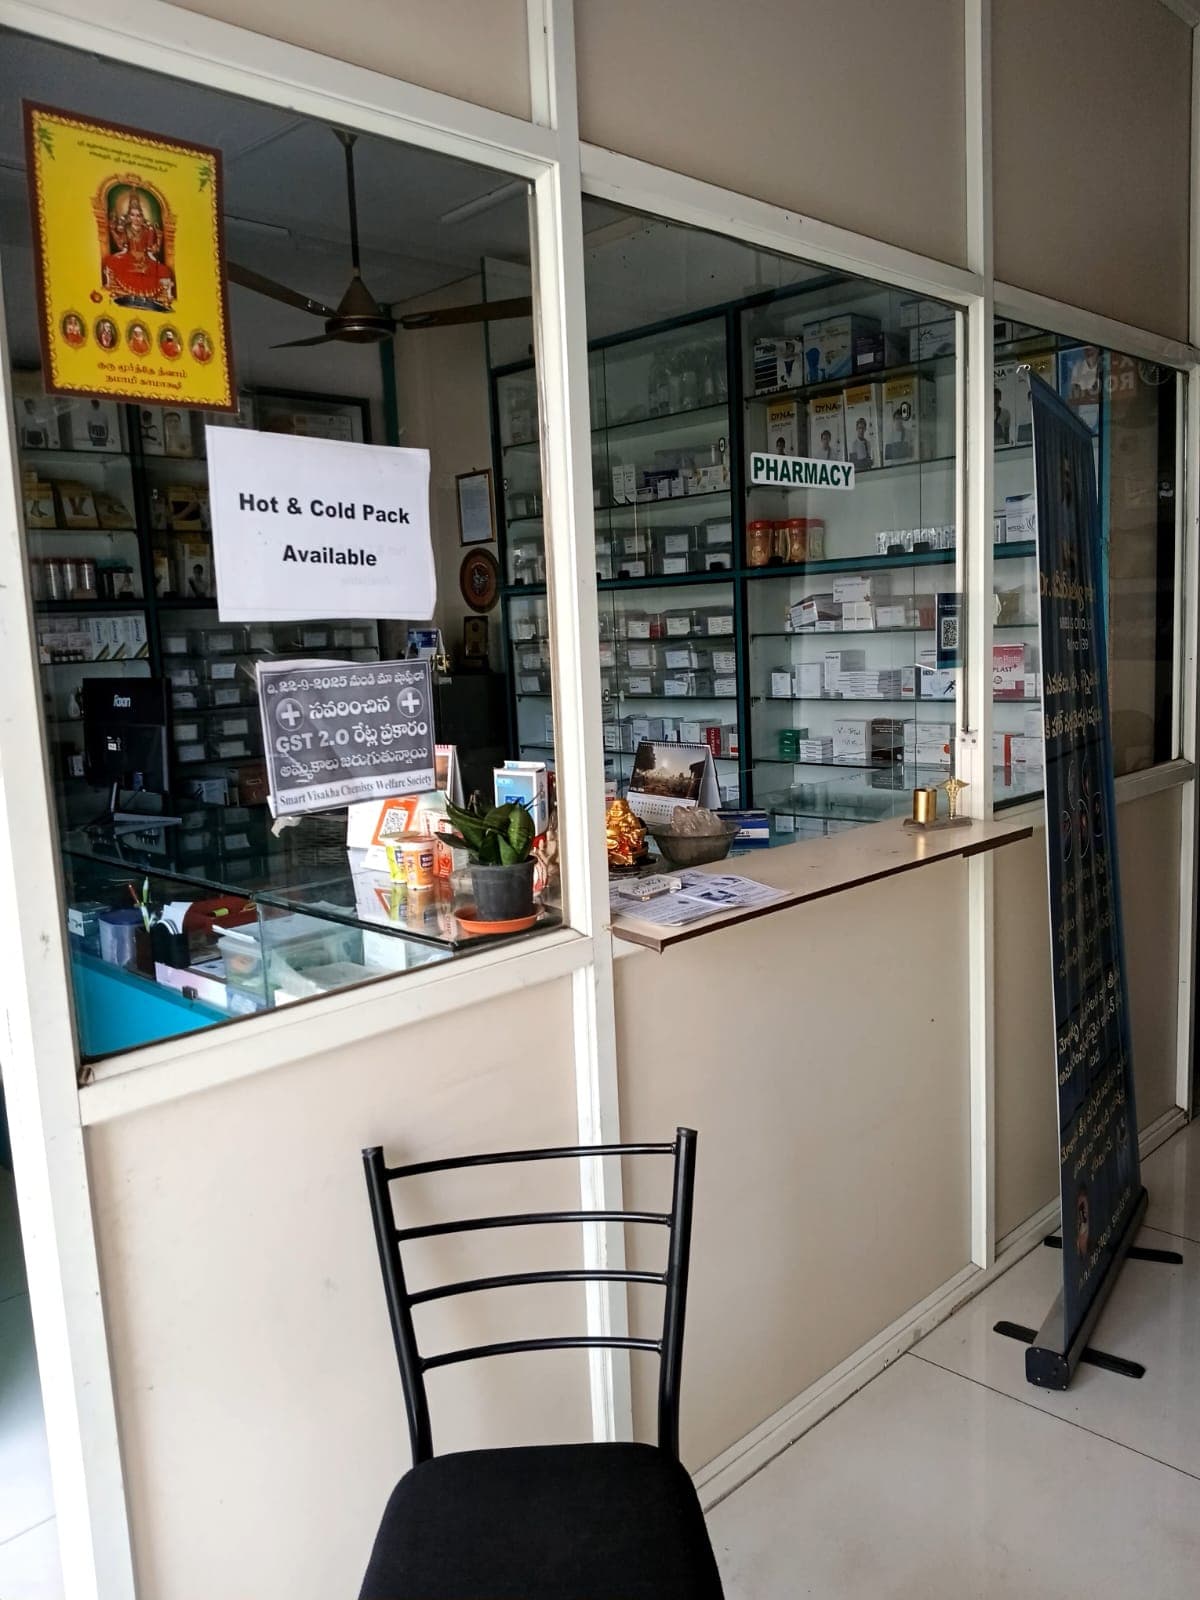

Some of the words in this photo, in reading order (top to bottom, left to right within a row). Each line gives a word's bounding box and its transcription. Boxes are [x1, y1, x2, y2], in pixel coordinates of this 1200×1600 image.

[753, 456, 852, 486] PHARMACY
[238, 492, 279, 514] Hot
[286, 497, 302, 515] &
[310, 499, 355, 520] Cold
[362, 504, 411, 524] Pack
[282, 544, 378, 567] Available
[278, 675, 347, 693] 22-9-2025
[309, 695, 390, 720] సవరించిన
[276, 732, 312, 753] GST
[318, 728, 349, 747] 2.0
[352, 722, 378, 747] రేట్ల
[380, 720, 428, 745] ప్రకారం
[340, 747, 428, 768] జరుగుతున్నాయి
[280, 795, 306, 806] Smart
[306, 787, 340, 801] Visakha
[341, 782, 374, 797] Chemists
[375, 778, 405, 790] Welfare
[406, 775, 432, 787] Society
